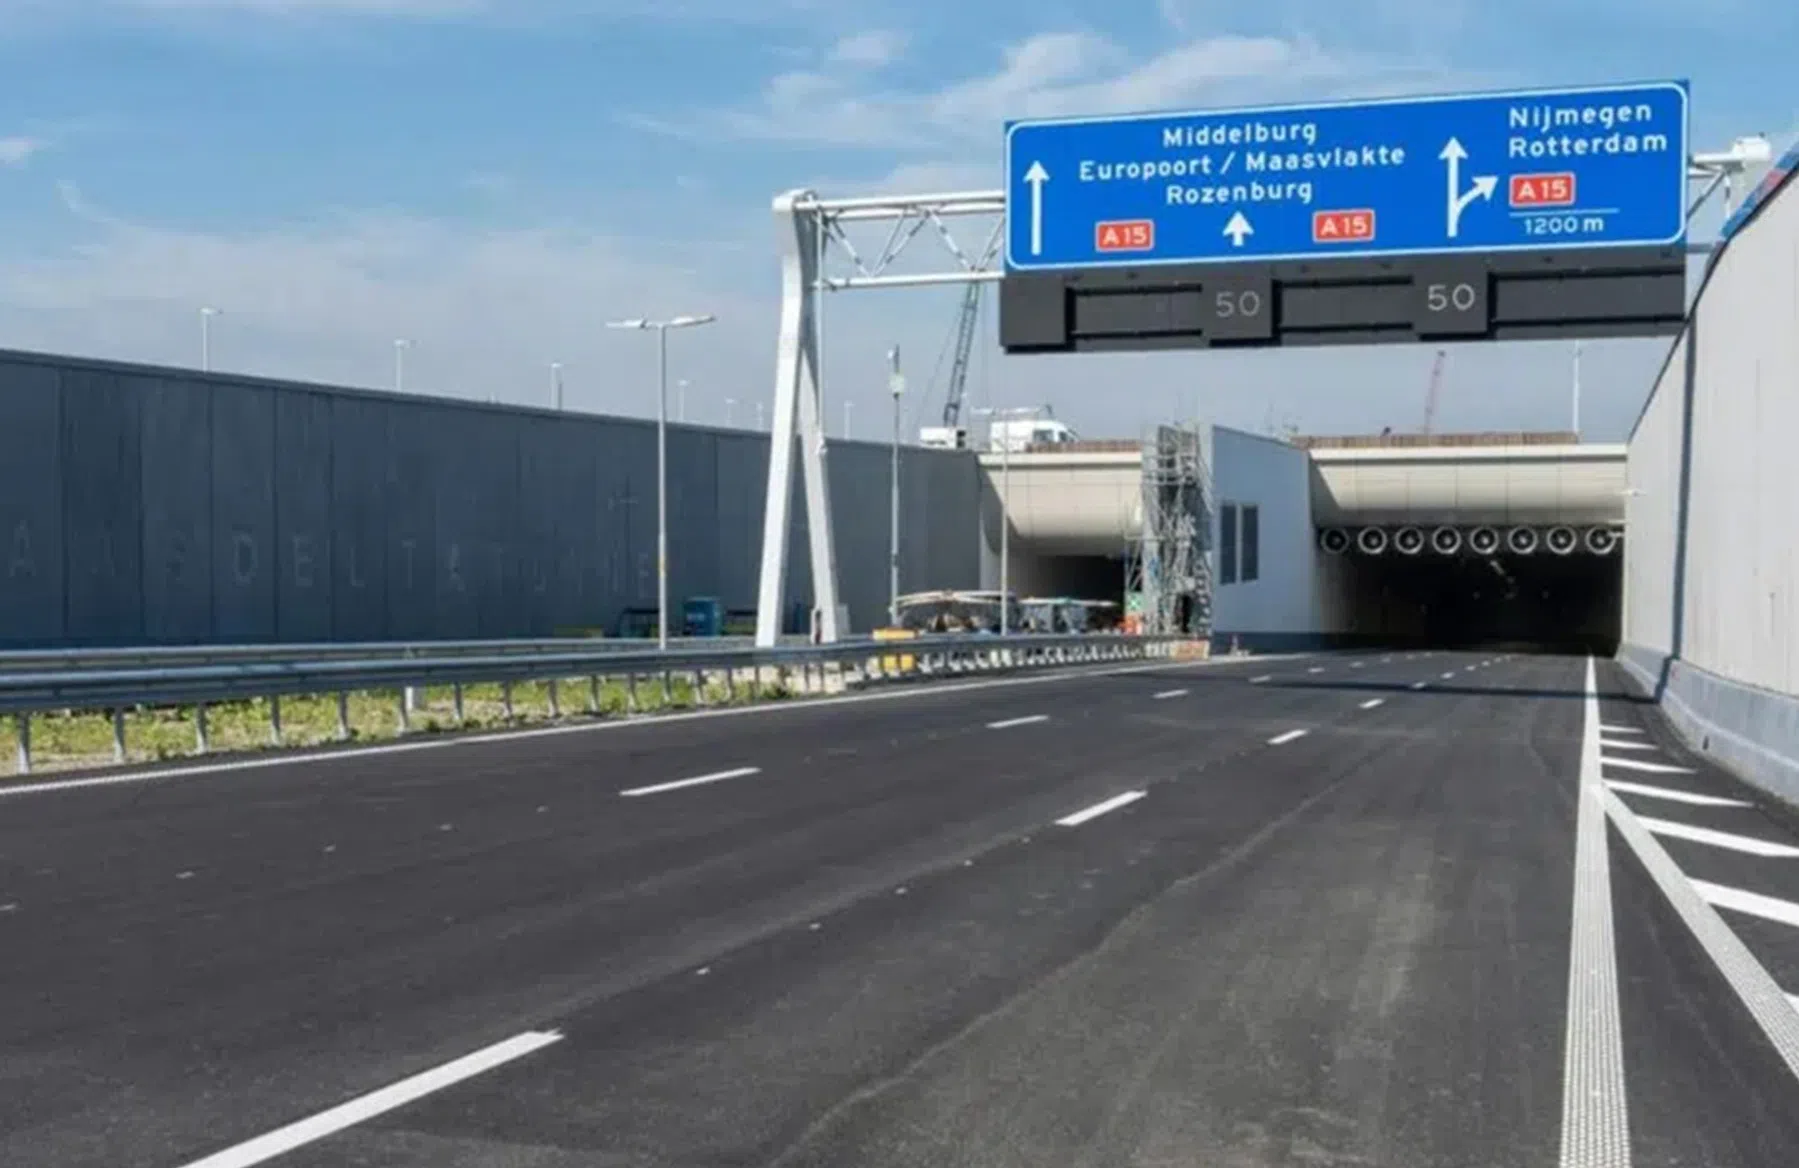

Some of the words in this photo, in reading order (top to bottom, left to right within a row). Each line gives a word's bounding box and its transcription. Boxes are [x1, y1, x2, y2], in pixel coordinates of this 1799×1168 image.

[1508, 104, 1653, 133] Nijmegen
[1163, 122, 1317, 147] Middelburg
[1508, 132, 1668, 158] Rotterdam
[1079, 155, 1212, 181] Europoort
[1245, 145, 1406, 172] Maasvlakte
[1166, 181, 1313, 205] Rozenburg
[1517, 179, 1568, 201] A15
[1102, 226, 1148, 246] A15
[1320, 215, 1368, 237] A15
[1524, 216, 1579, 235] 1200
[1582, 217, 1604, 233] m
[1215, 290, 1261, 318] 50
[1427, 283, 1477, 312] 50
